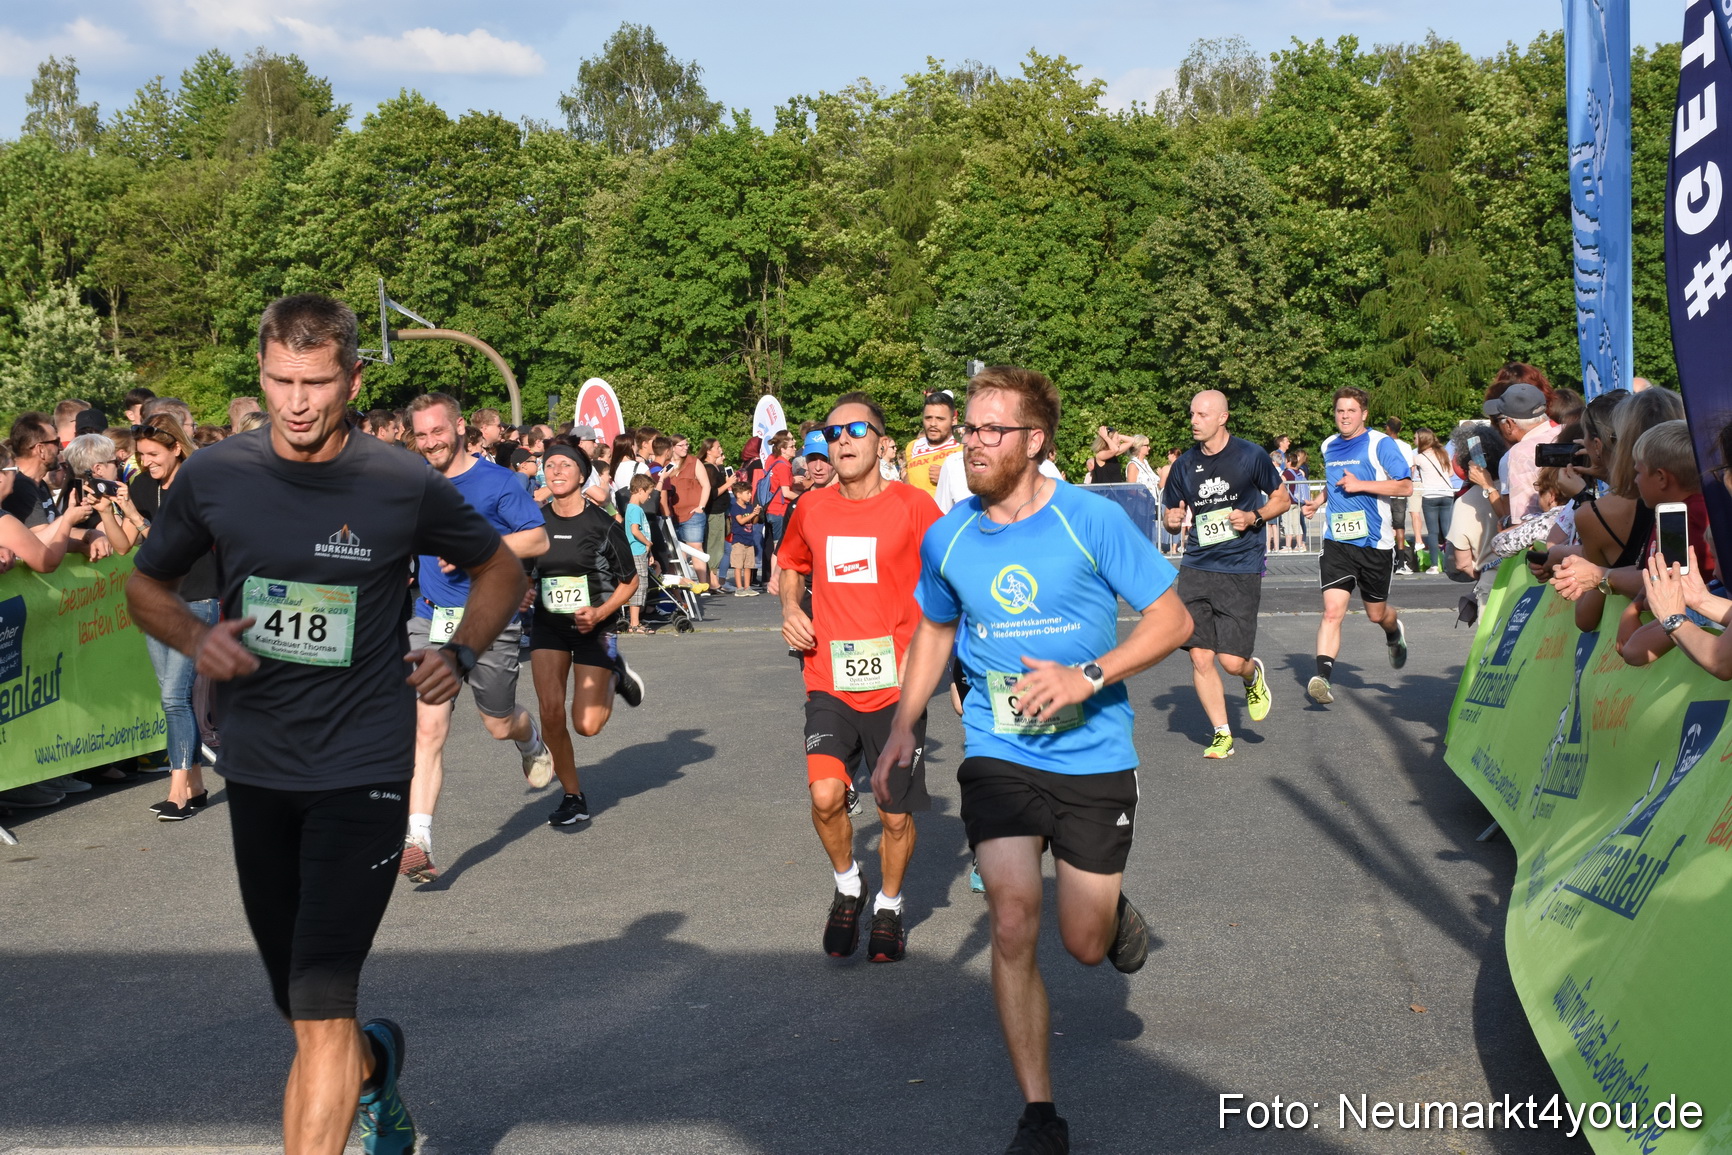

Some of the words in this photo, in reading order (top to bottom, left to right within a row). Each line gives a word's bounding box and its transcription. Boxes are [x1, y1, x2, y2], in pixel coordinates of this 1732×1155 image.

[908, 457, 930, 469] MAX
[1203, 520, 1226, 536] 391
[1335, 520, 1361, 533] 2151
[315, 543, 372, 558] BURKHARDT
[843, 564, 860, 573] DEHN
[548, 588, 583, 604] 1972
[264, 609, 328, 643] 418
[990, 616, 1063, 630] Handwerkskammer
[993, 622, 1082, 639] Niederbayern-Oberpfalz
[255, 634, 301, 651] Kainzbauer
[303, 642, 338, 653] Thomas
[846, 657, 882, 676] 528
[0, 652, 63, 724] enlauf
[381, 791, 402, 802] JAKO
